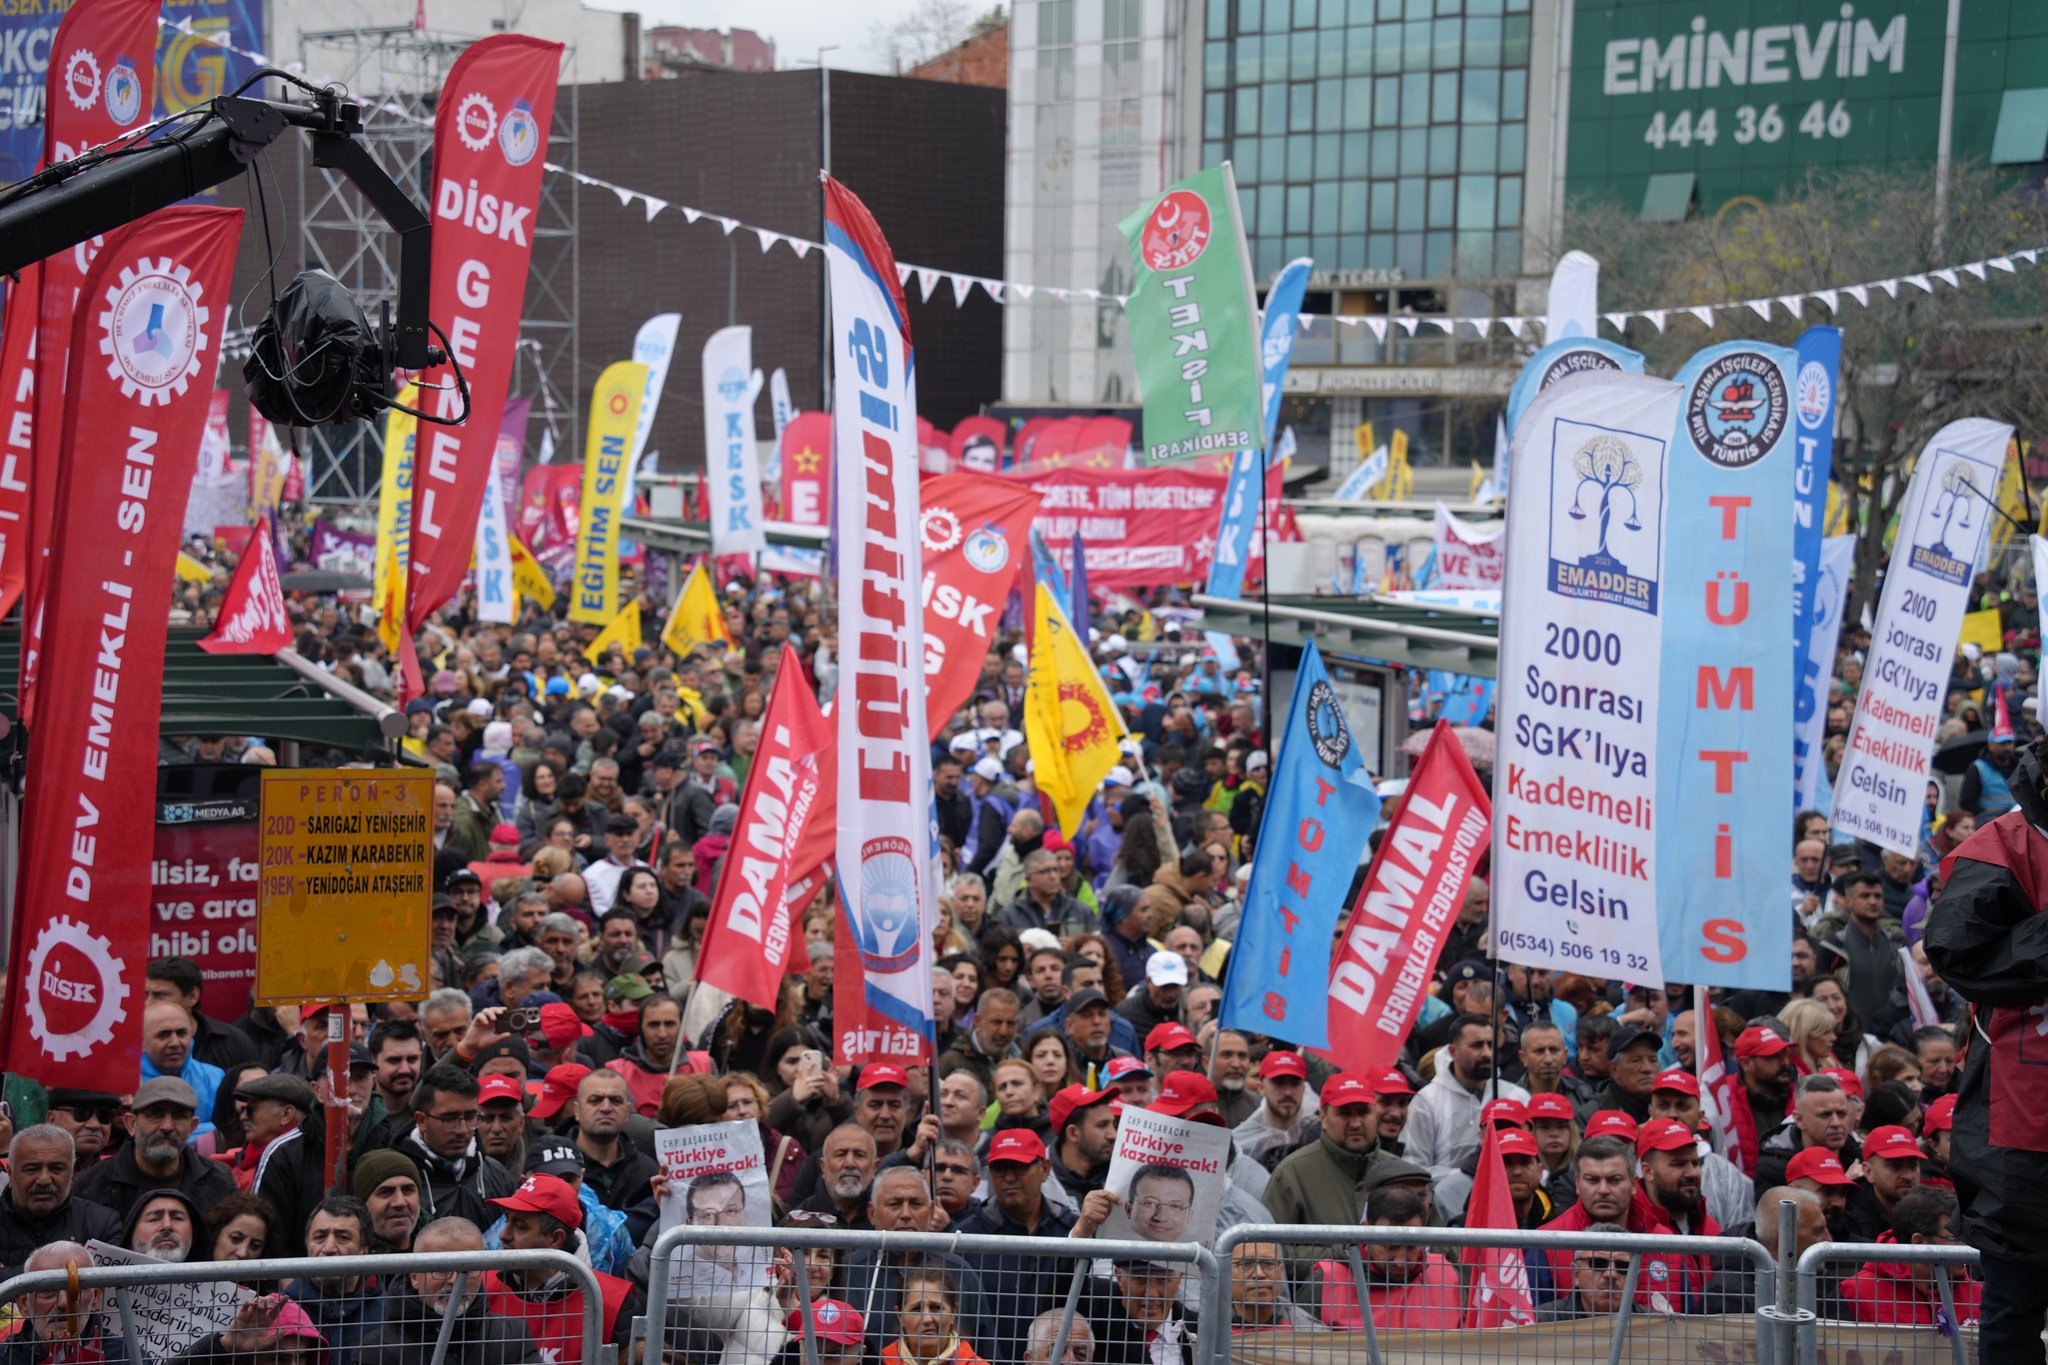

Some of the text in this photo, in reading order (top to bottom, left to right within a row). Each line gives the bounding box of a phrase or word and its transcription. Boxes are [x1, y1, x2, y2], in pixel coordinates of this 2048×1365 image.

[1604, 1, 1908, 95] EMİNEVİM
[1645, 99, 1851, 149] 444 36 46
[437, 178, 532, 247] DİSK
[1691, 367, 1723, 414] TAŞIMA
[1720, 355, 1772, 375] İŞÇİLERİ
[1761, 371, 1784, 444] SENDİKASI
[117, 426, 158, 534] SEN
[725, 412, 752, 532] KESK
[582, 435, 625, 610] EĞİTİM SEN
[921, 571, 994, 637] İSK
[1557, 563, 1650, 600] EMADDER
[1545, 621, 1622, 667] 2000
[83, 580, 133, 781] EMEKLİ
[1526, 664, 1643, 724] Sonrası
[1695, 496, 1754, 963] TÜMTİS
[1507, 762, 1651, 831] Kademeli
[1851, 765, 1907, 806] Gelsin
[66, 793, 101, 902] DEV
[266, 815, 296, 835] 20D
[365, 809, 426, 838] YENİŞEHİR
[228, 857, 259, 882] fa
[266, 846, 294, 865] 20K
[351, 840, 425, 863] KARABEKİR
[1506, 814, 1648, 882] Emeklilik
[263, 875, 295, 896] 19EK
[371, 871, 424, 897] ATAŞEHİR
[1263, 775, 1337, 1022] TÜMTİS
[1328, 791, 1459, 1016] DAMAL
[1525, 869, 1629, 921] Gelsin
[157, 898, 257, 921] ve ara
[1376, 804, 1490, 1038] DERNEKLER FEDERASYONU
[148, 929, 211, 958] hibi
[1500, 929, 1649, 972] 0(534) 506 19 32
[43, 959, 97, 1004] DİSK
[200, 967, 244, 981] tibaren
[663, 1131, 729, 1149] CHP BAŞARACAK
[1124, 1127, 1184, 1156] Türkiye
[1142, 1119, 1192, 1139] BAŞARACAK
[542, 1146, 576, 1163] BJK
[664, 1146, 727, 1166] Türkiye
[1119, 1143, 1219, 1174] kazanacak!
